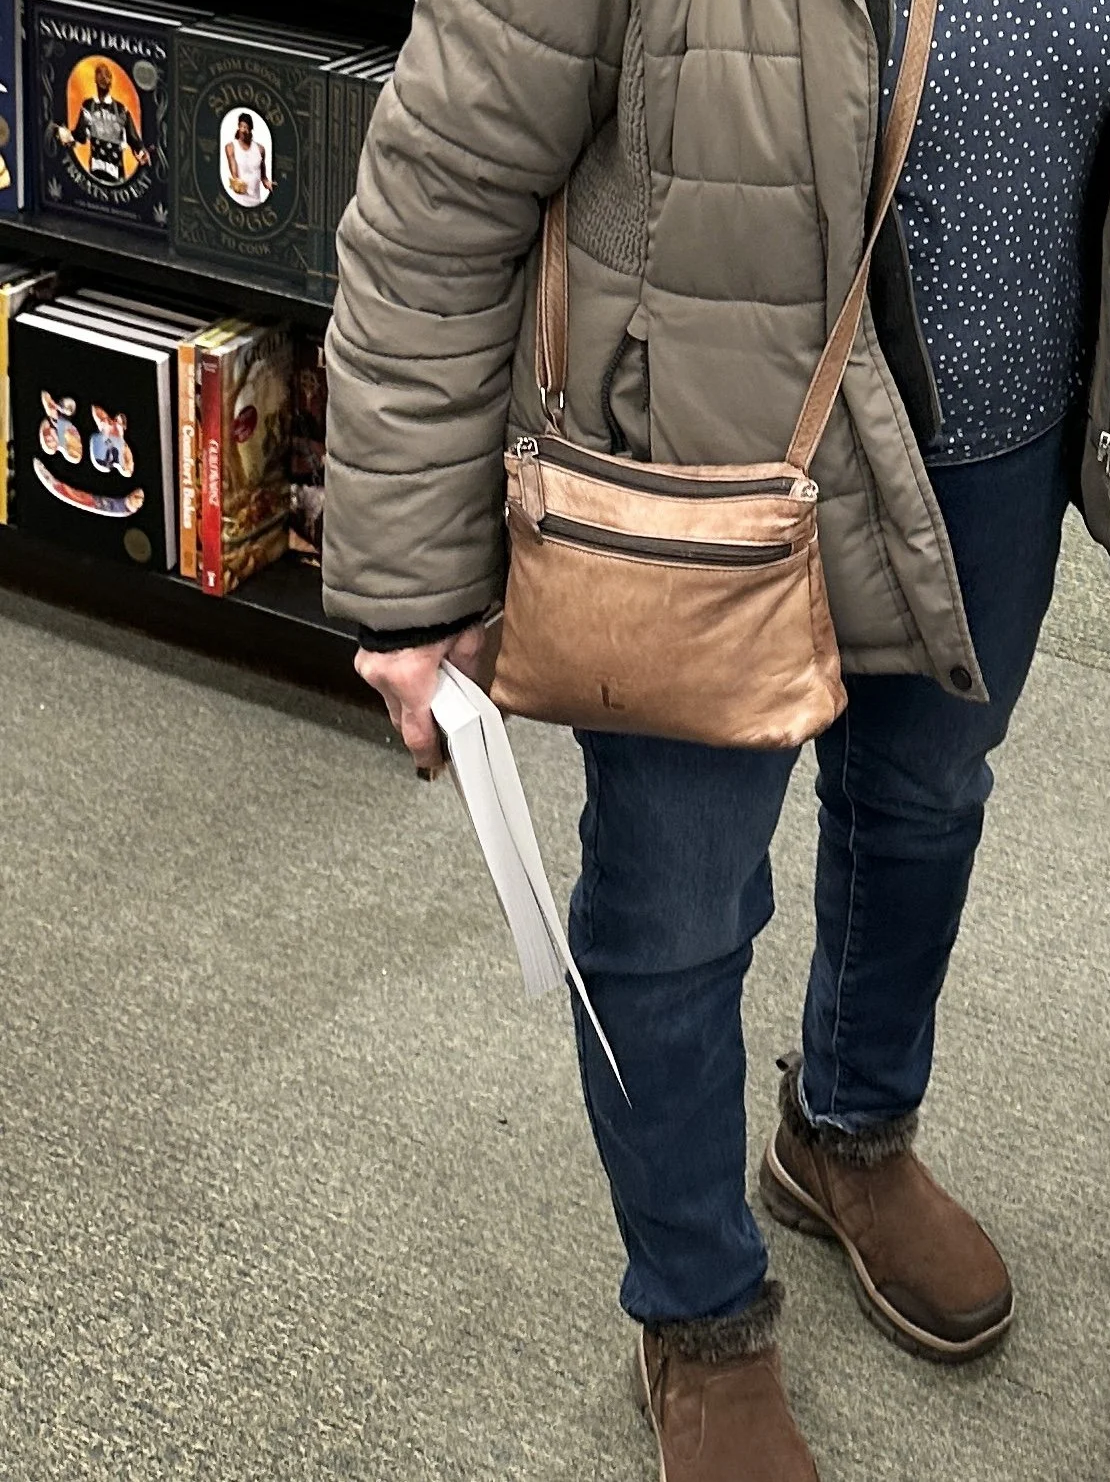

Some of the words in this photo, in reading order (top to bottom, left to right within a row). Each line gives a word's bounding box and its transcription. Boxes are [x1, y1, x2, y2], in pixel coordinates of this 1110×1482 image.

[39, 17, 98, 47] SNOOP
[99, 32, 167, 60] DOGG'S
[208, 82, 285, 127] SNOOP
[110, 188, 131, 204] TO
[213, 193, 279, 233] DOGG
[237, 237, 272, 256] COOK
[182, 424, 196, 486] Comfort
